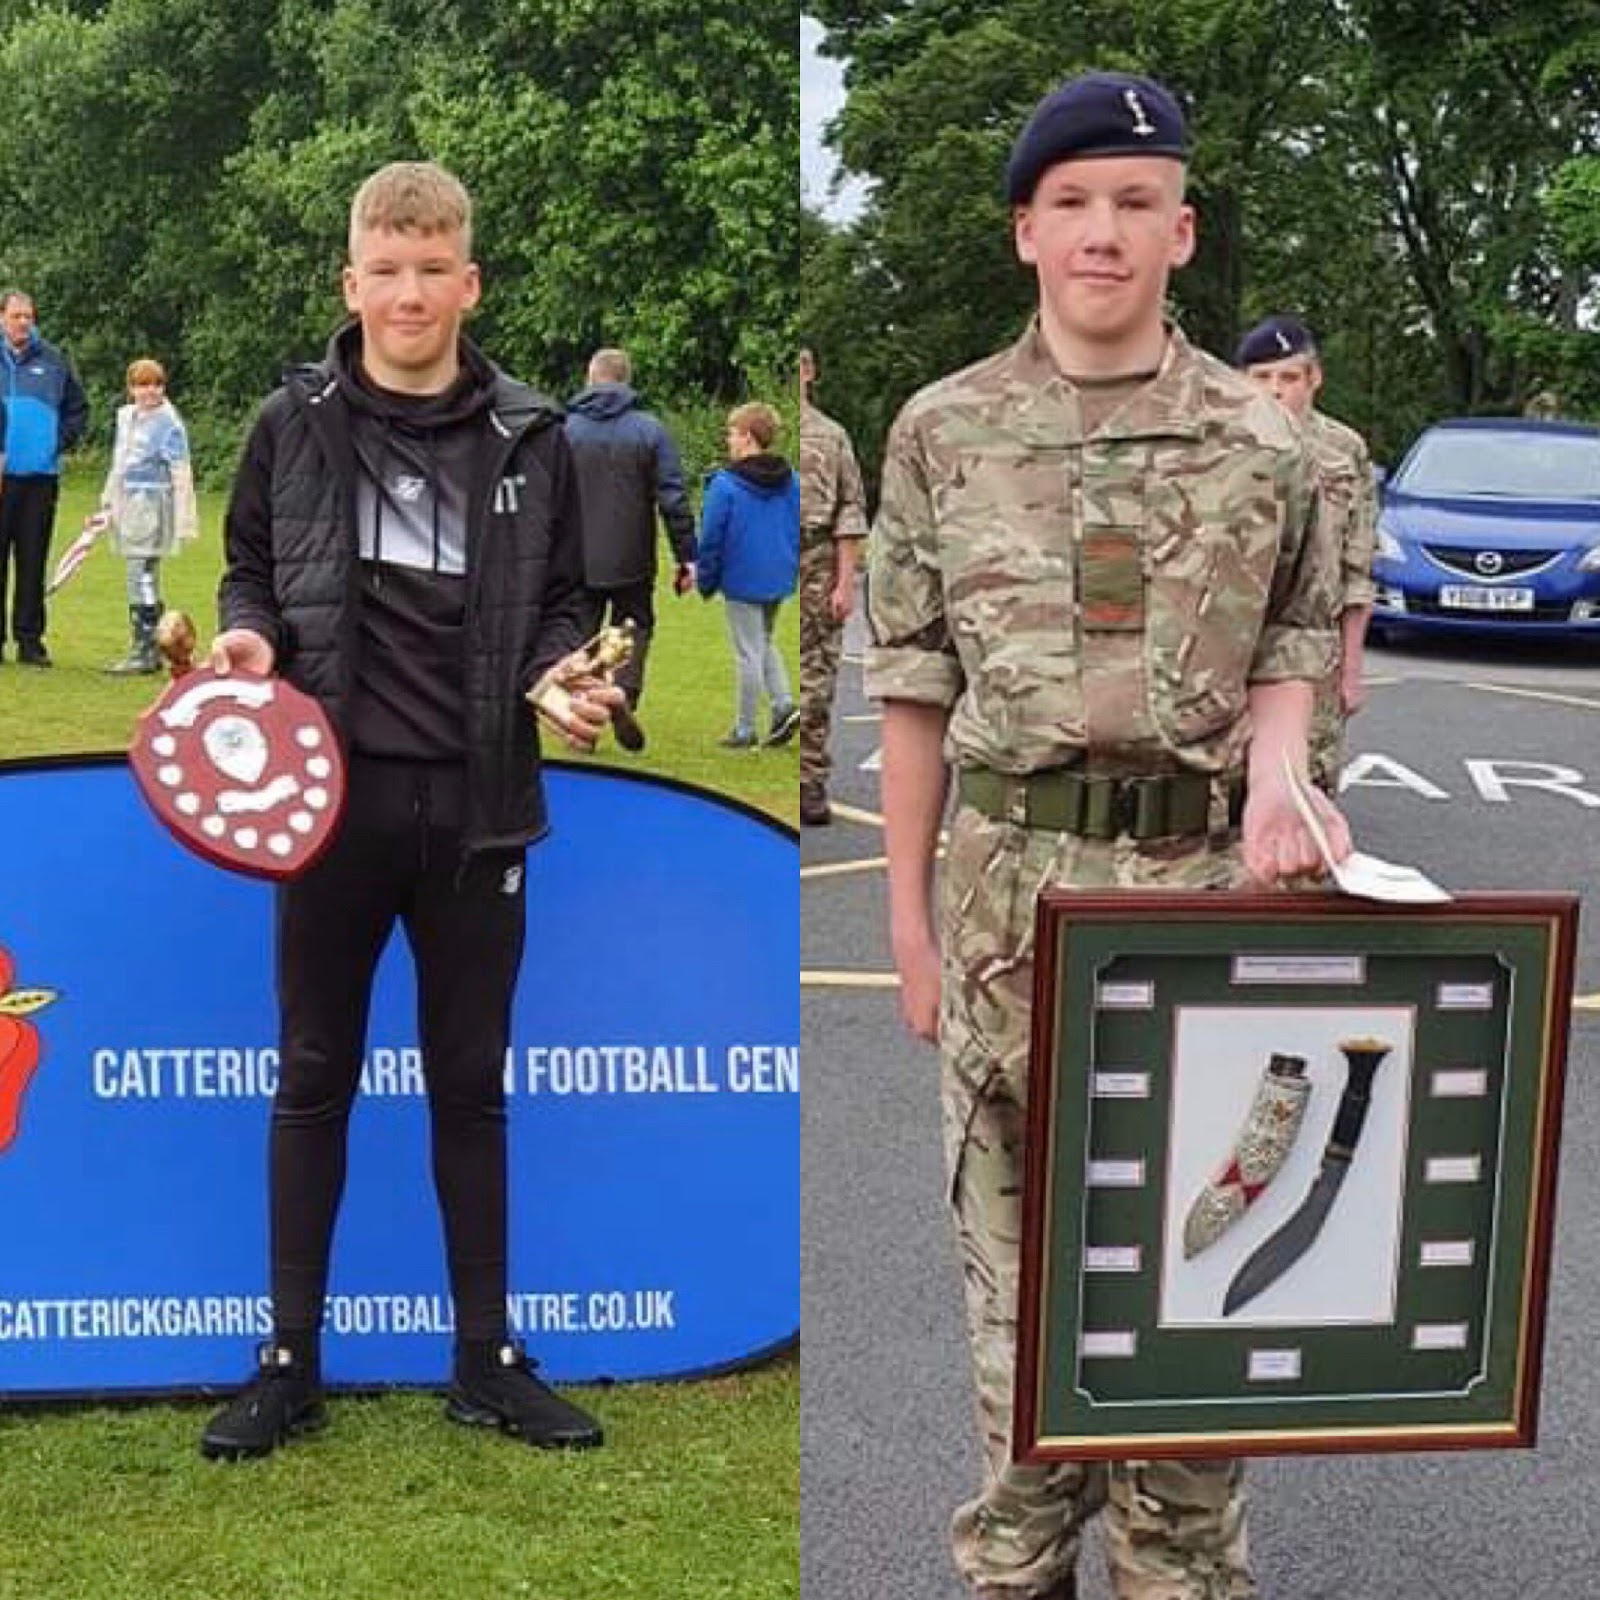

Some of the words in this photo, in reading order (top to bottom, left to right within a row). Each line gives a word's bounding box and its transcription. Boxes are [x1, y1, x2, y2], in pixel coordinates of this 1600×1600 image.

[93, 1048, 280, 1098] CATTERIC
[527, 1046, 720, 1095] FOOTBALL
[727, 1045, 799, 1093] CEN
